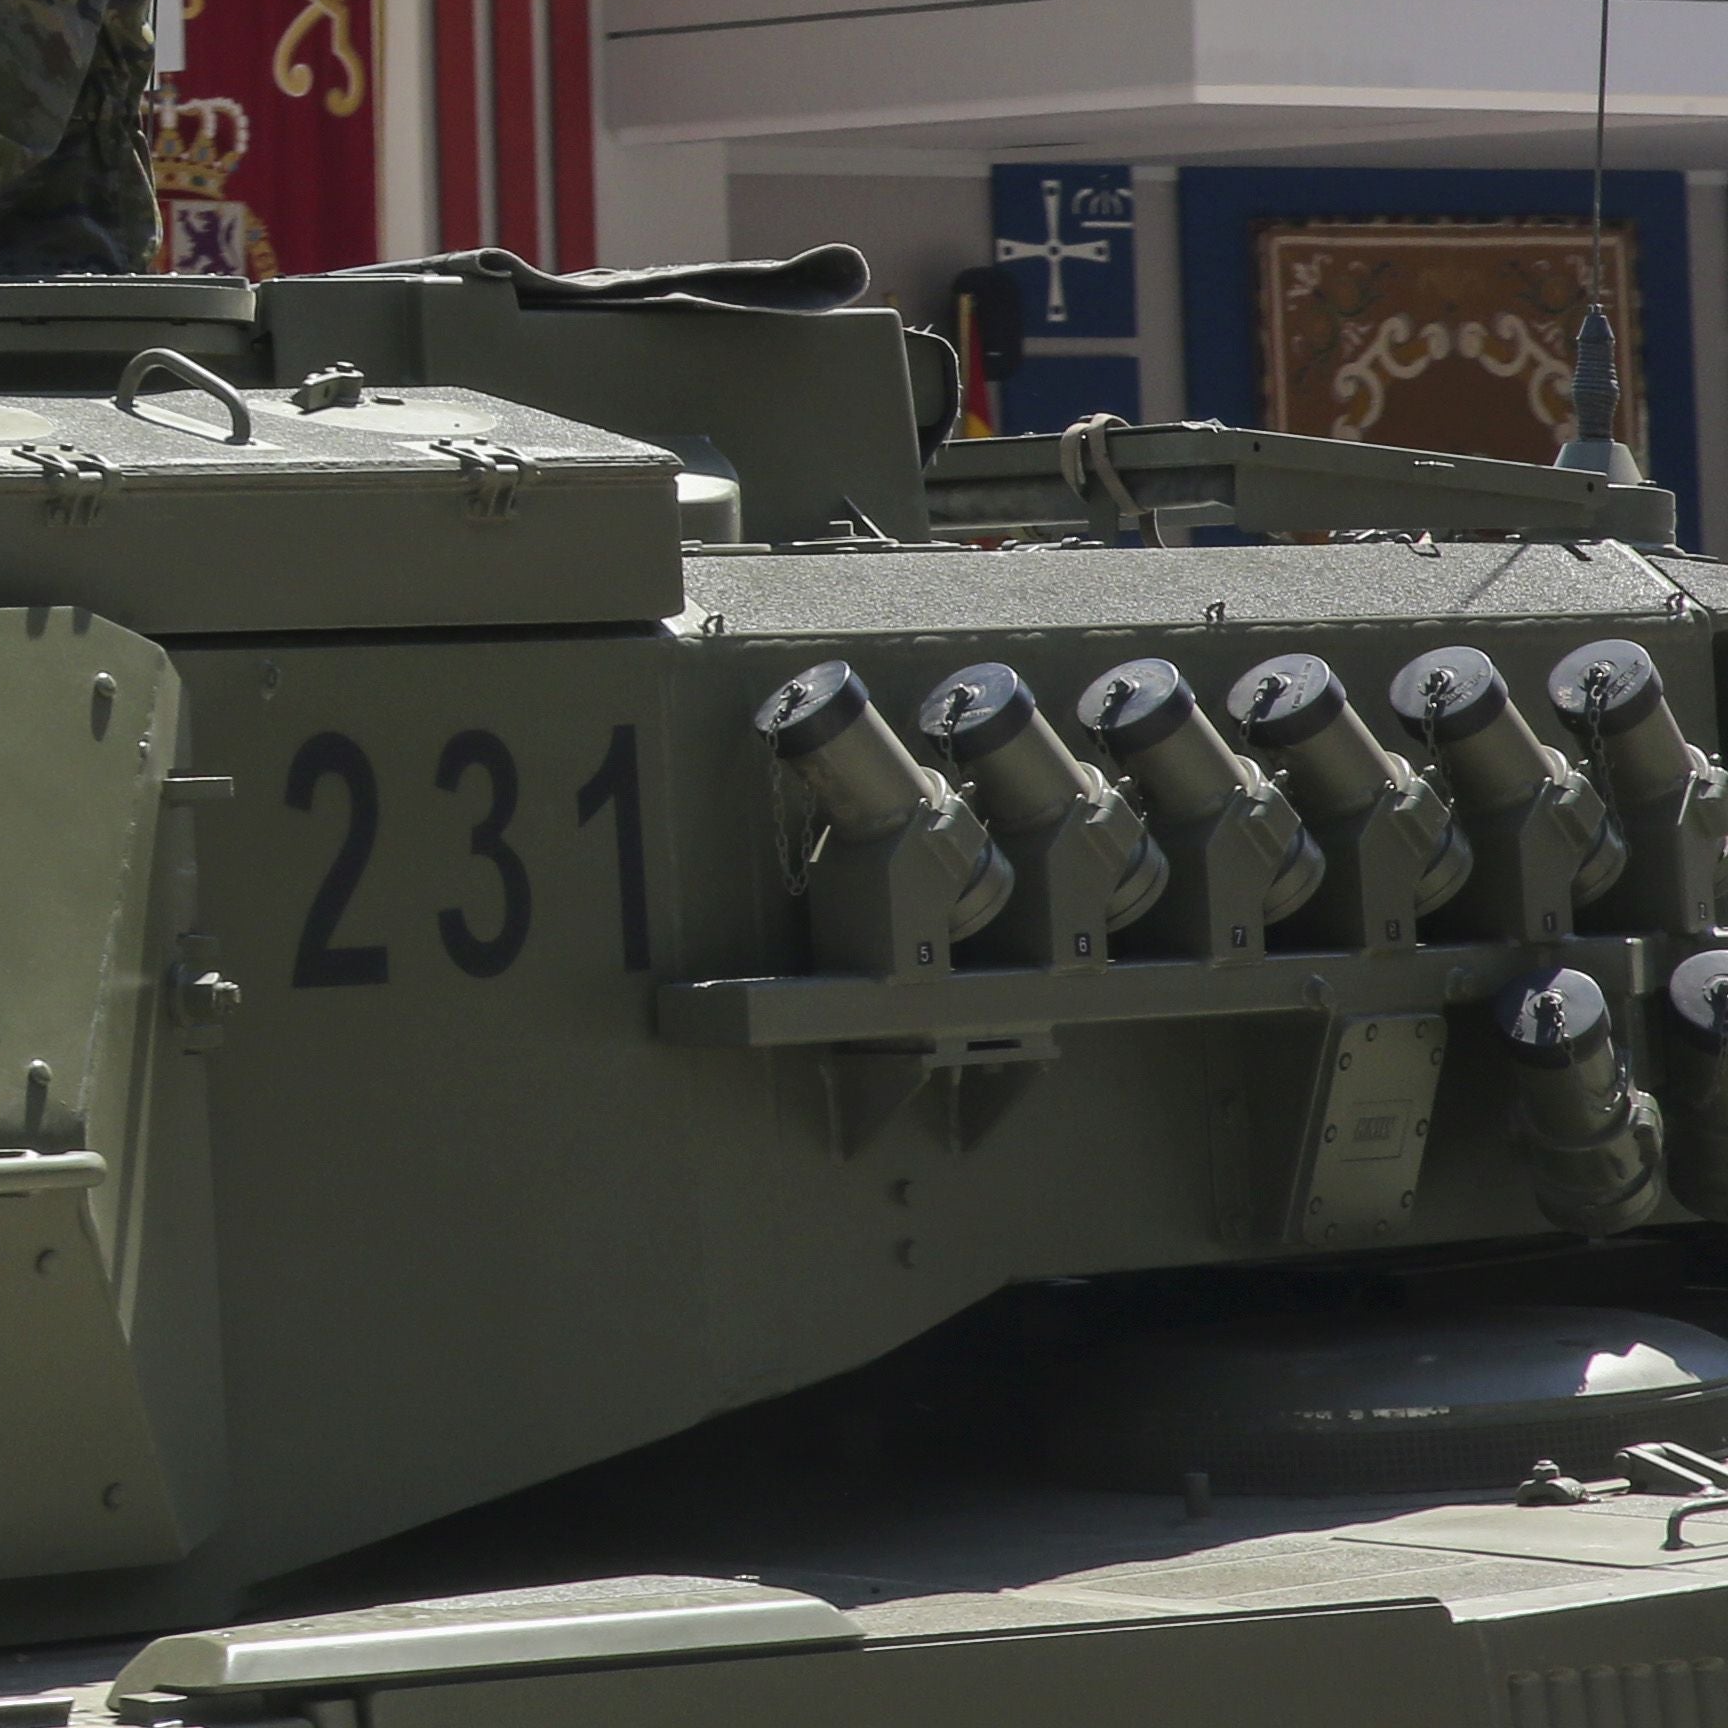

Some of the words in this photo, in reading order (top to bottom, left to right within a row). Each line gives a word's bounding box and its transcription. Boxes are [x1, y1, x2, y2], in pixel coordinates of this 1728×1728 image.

[285, 724, 651, 988] 231
[1078, 936, 1088, 953] 6
[1234, 928, 1244, 945] 7
[920, 946, 930, 962] 5
